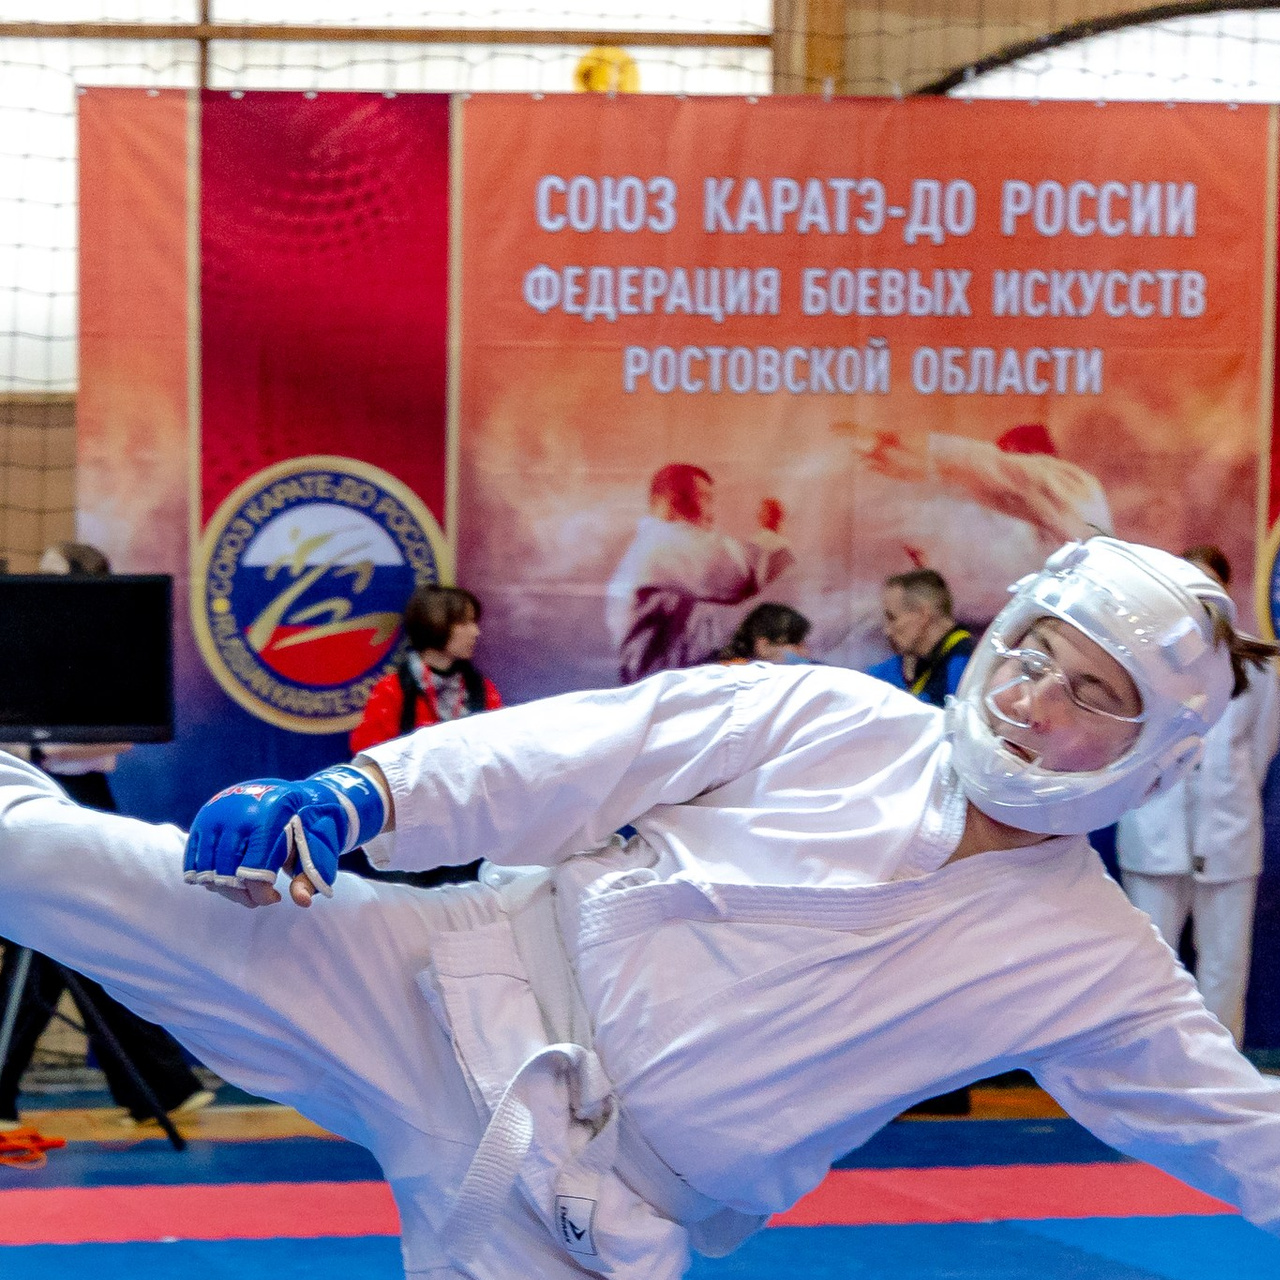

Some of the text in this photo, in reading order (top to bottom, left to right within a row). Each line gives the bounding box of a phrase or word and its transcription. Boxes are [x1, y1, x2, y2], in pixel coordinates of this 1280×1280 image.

[534, 174, 1198, 245] СОЮЗ КАРАТЭ-ДО РОССИИ
[521, 262, 1208, 323] ФЕДЕРАЦИЯ БОЕВЫХ ИСКУССТВ
[622, 338, 1104, 396] РОСТОВСКОЙ ОБЛАСТИ
